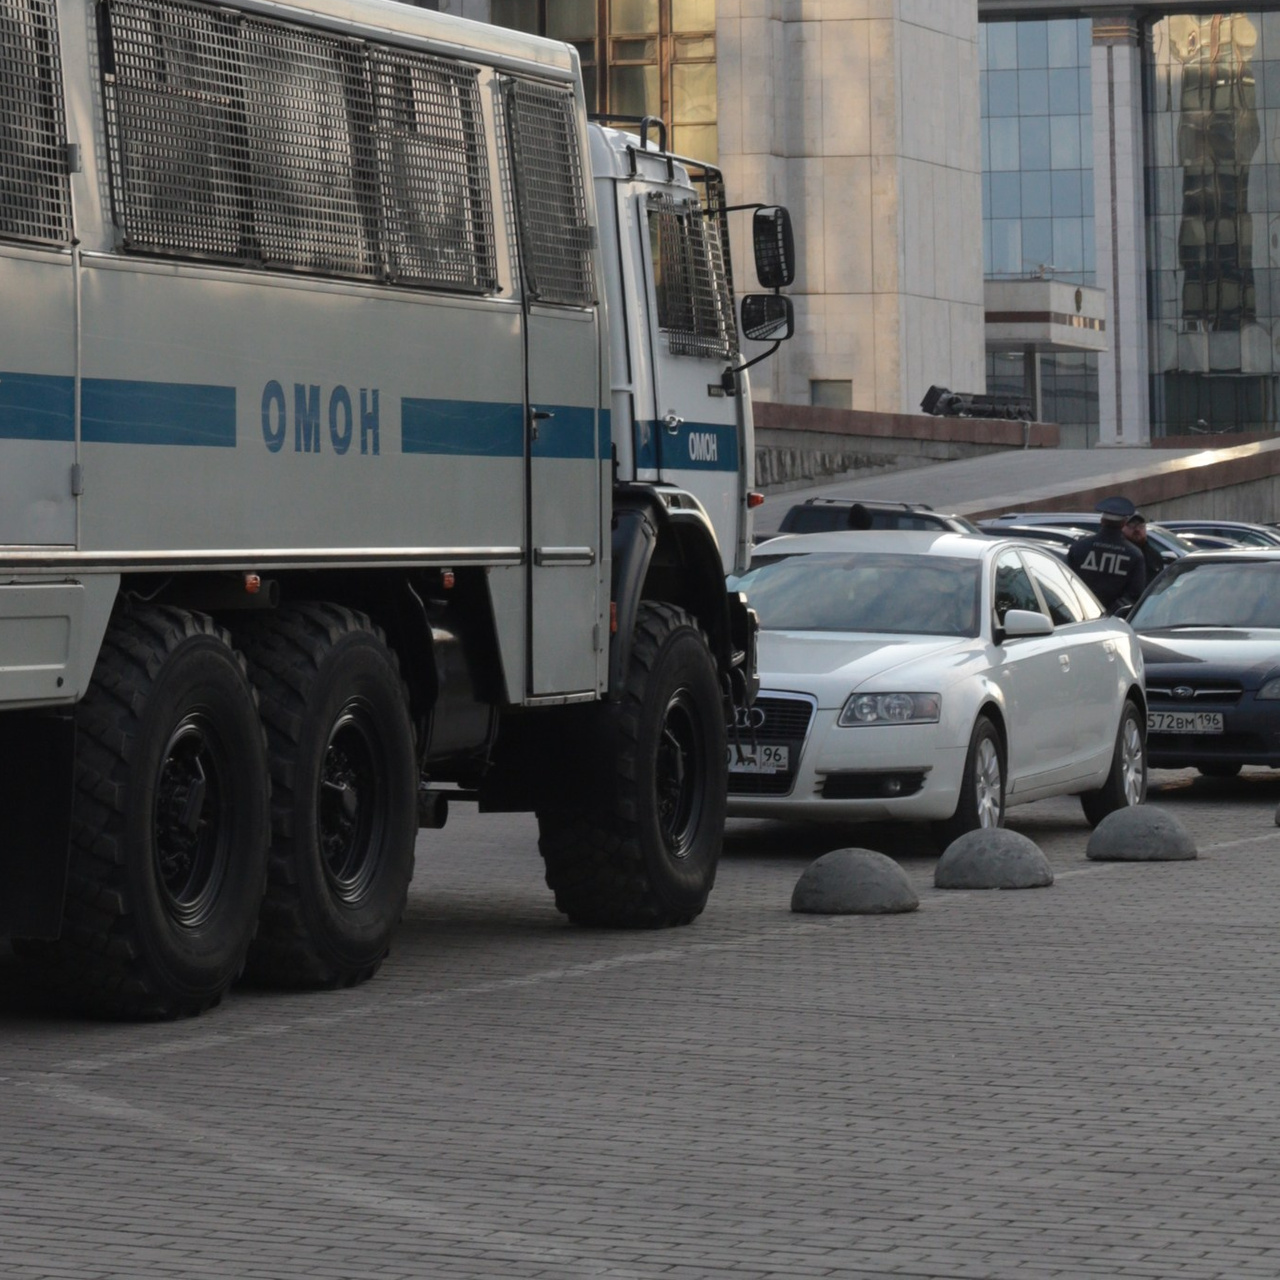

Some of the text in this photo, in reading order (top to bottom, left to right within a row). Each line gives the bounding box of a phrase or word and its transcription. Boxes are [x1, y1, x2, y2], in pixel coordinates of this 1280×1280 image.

[261, 379, 380, 455] ОМОН
[689, 432, 718, 461] ОМОН
[1080, 550, 1131, 576] ДПС
[1198, 713, 1219, 726] 196
[763, 747, 782, 762] 96
